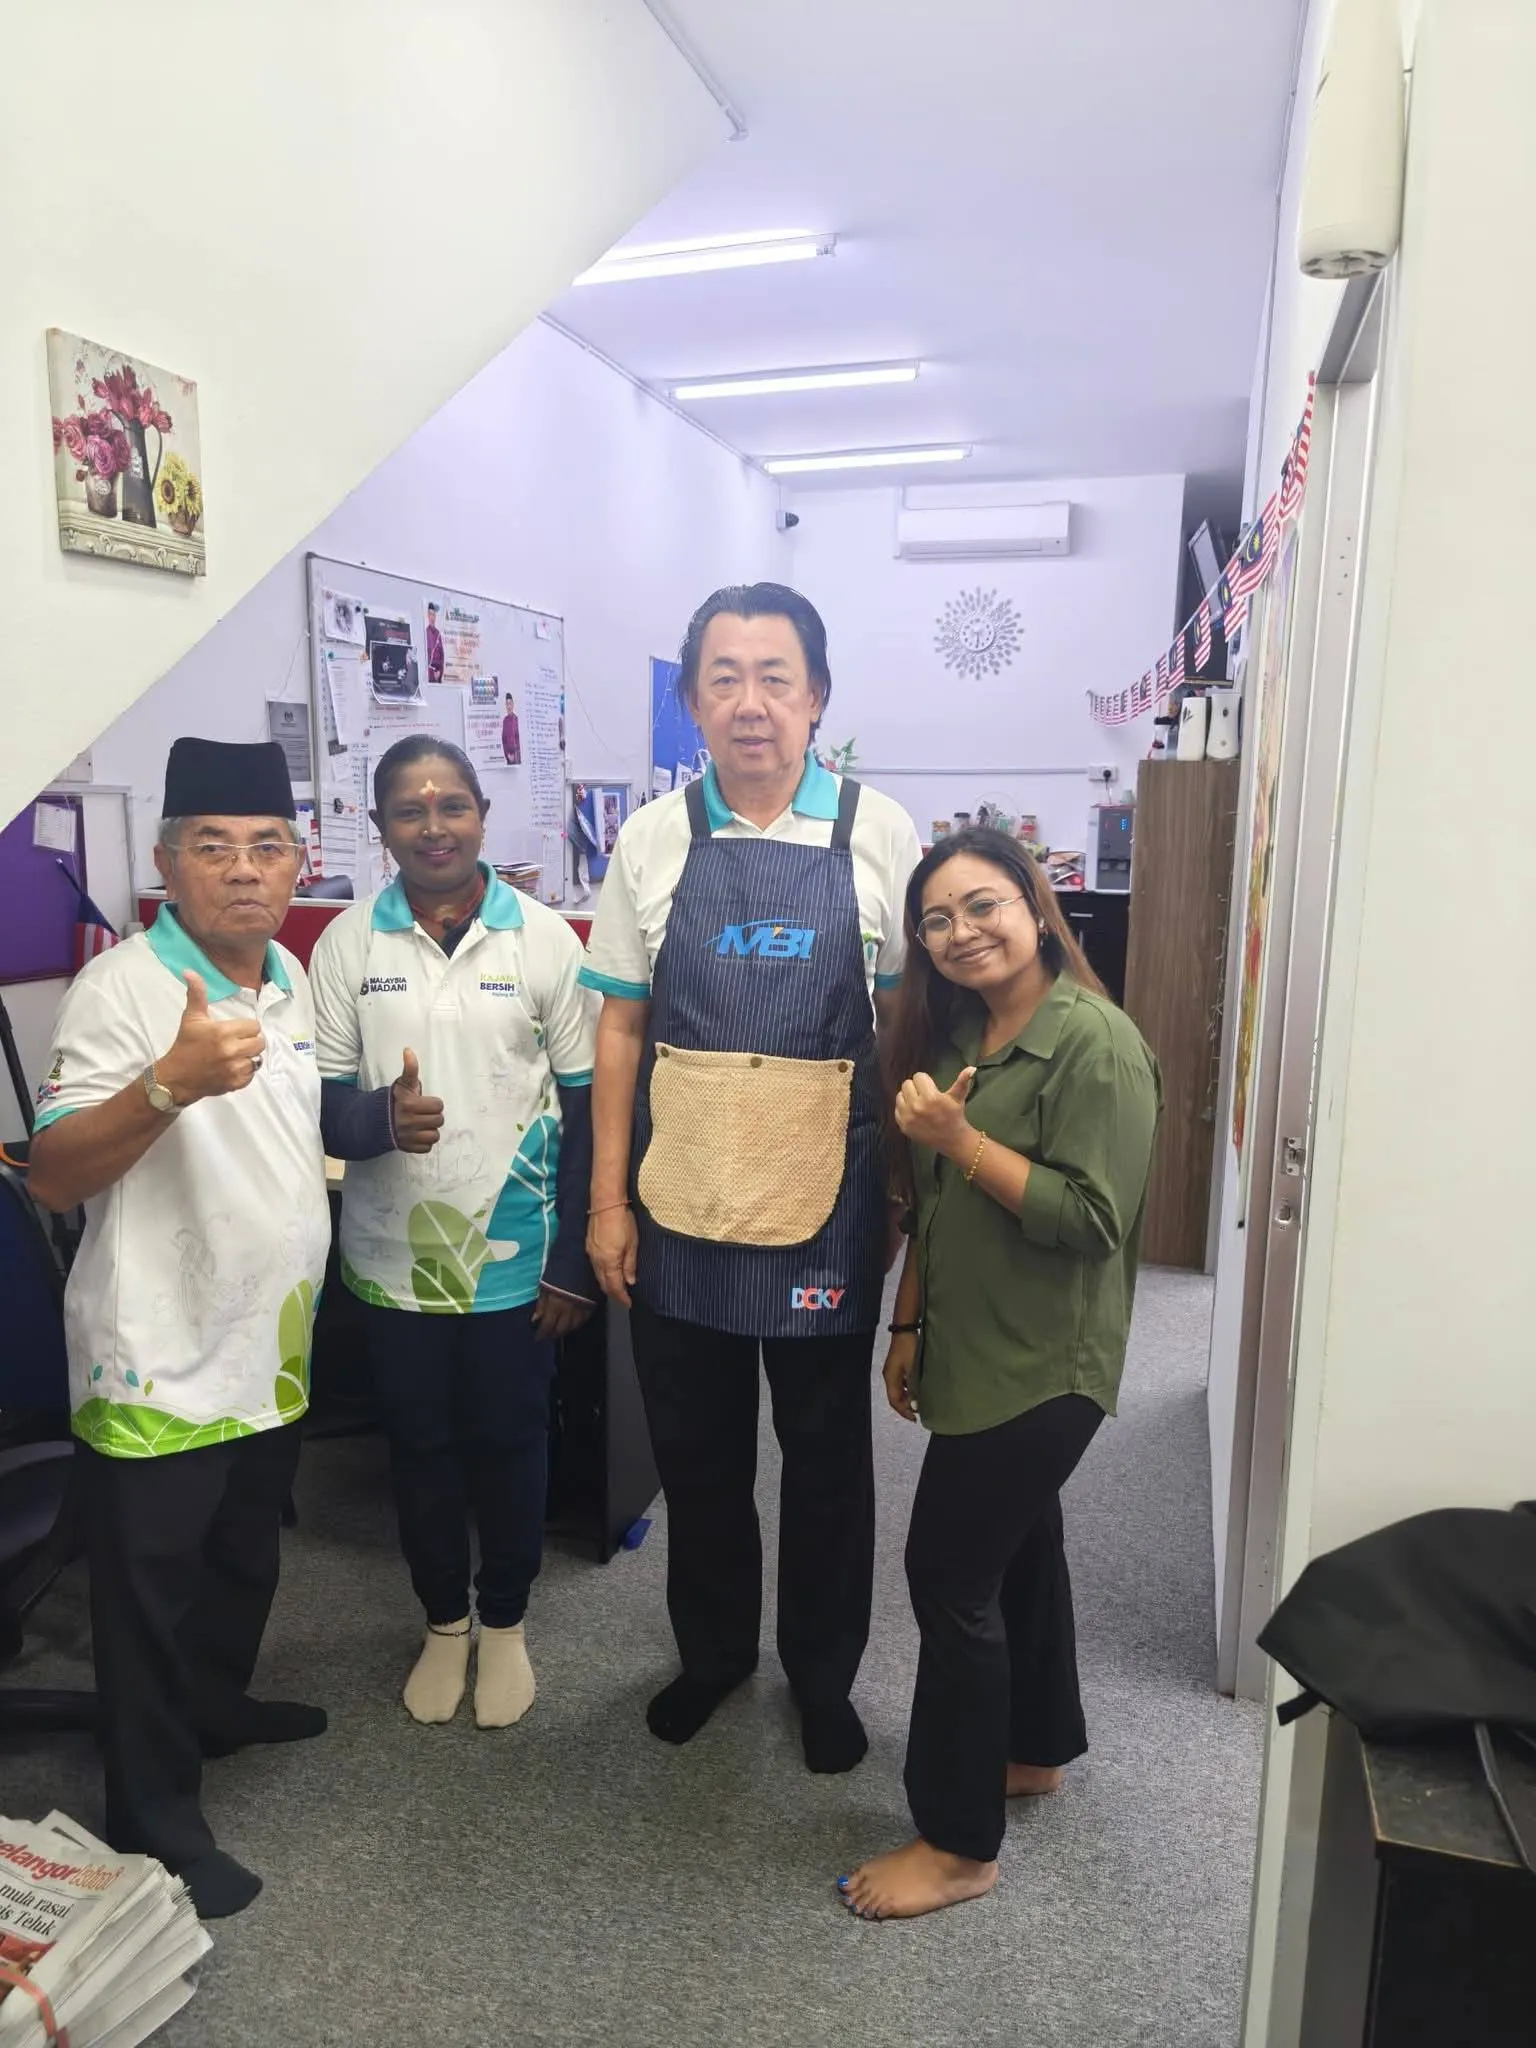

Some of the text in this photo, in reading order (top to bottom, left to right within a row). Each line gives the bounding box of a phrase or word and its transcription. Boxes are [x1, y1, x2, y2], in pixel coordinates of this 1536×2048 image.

[717, 925, 816, 960] MBI
[370, 984, 407, 992] MADANI
[480, 982, 515, 991] BERSIH
[13, 1911, 56, 1936] Teluk
